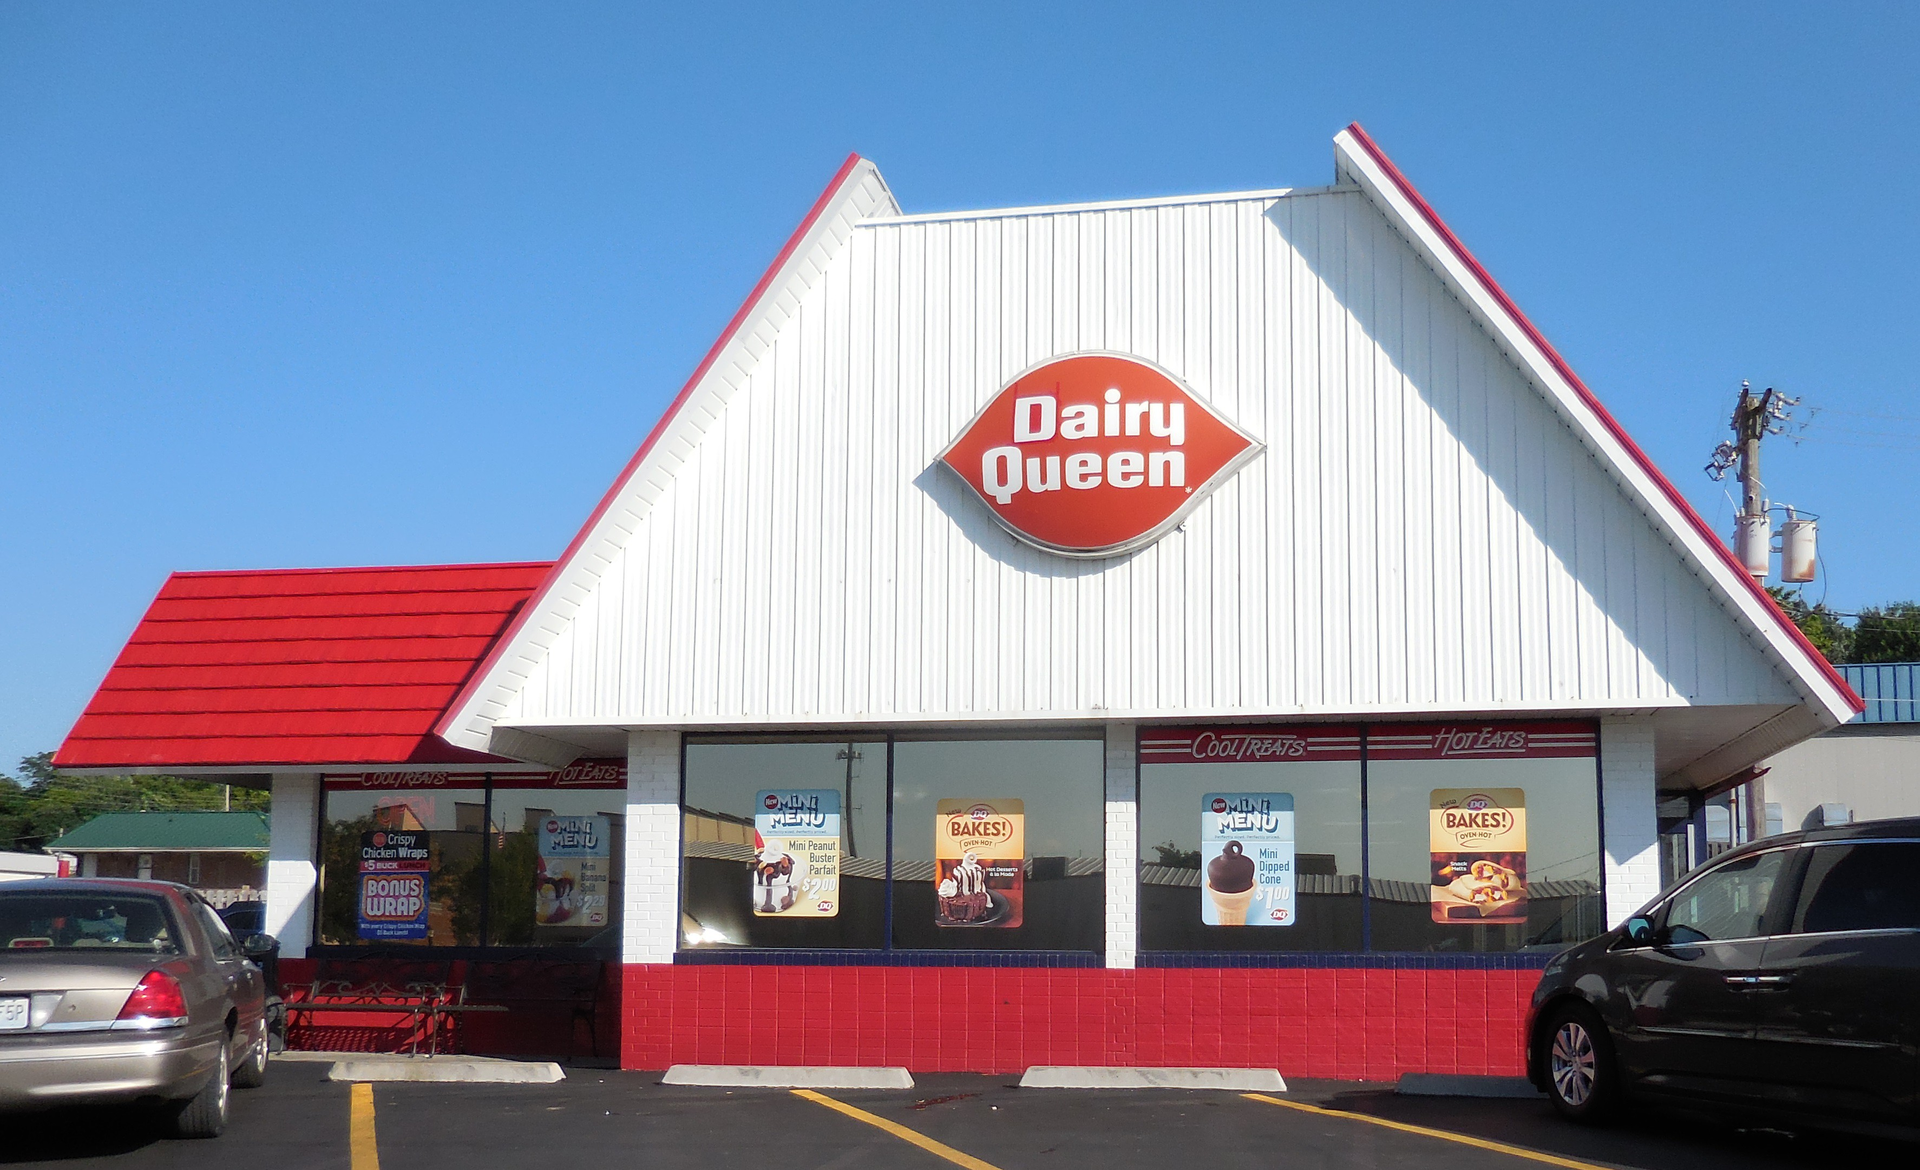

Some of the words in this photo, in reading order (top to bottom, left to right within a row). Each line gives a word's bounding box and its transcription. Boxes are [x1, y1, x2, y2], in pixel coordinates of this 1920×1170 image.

[1014, 388, 1185, 446] Dairy
[982, 446, 1185, 505] Queen
[1469, 800, 1486, 808] DQ
[972, 810, 988, 818] DQ
[1446, 812, 1507, 829] BAKES!
[951, 821, 1006, 837] BAKES!
[387, 833, 416, 847] Crispy
[788, 840, 806, 851] Mini
[808, 840, 836, 851] Peanut
[362, 847, 397, 859] Chicken
[398, 847, 428, 860] Wraps
[809, 852, 836, 863] Buster
[1259, 848, 1278, 859] Mini
[581, 862, 596, 871] Mini
[809, 864, 836, 875] Parfait
[1259, 861, 1290, 874] Dipped
[581, 874, 607, 882] Banana
[1259, 873, 1281, 884] Cone
[367, 879, 420, 896] BONUS
[581, 884, 596, 895] Split
[366, 897, 421, 916] WRAP
